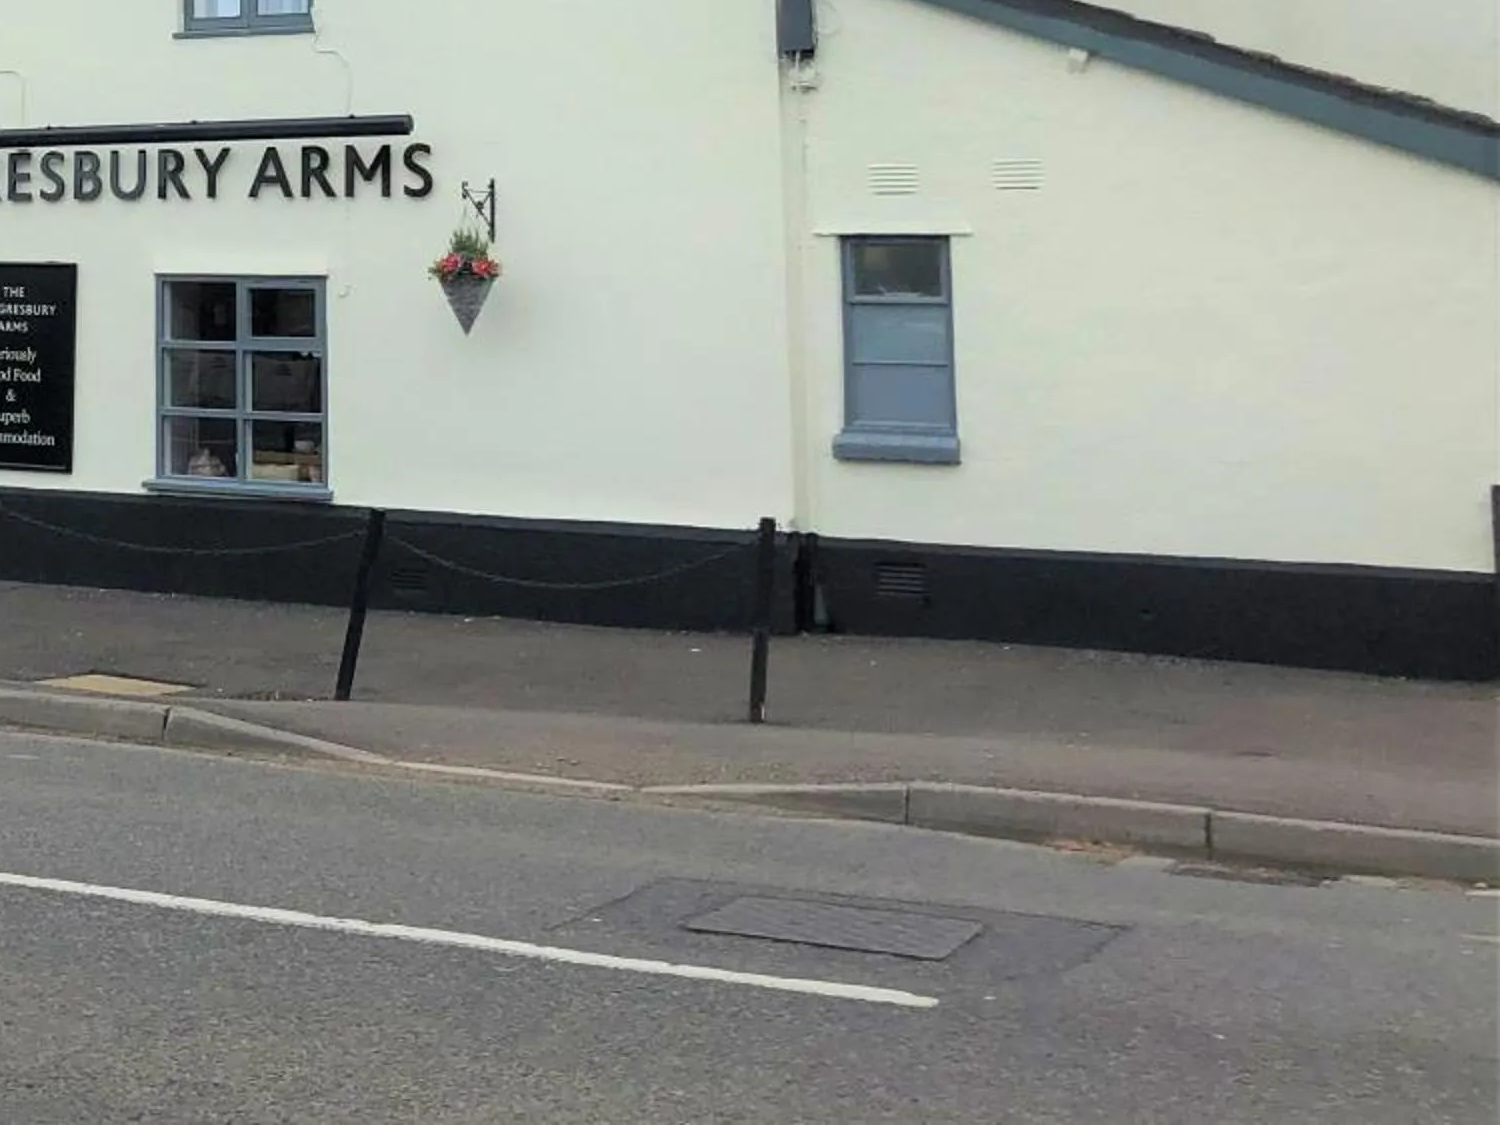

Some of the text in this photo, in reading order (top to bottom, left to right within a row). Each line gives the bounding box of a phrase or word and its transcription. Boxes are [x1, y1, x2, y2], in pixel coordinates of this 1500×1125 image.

[248, 142, 435, 199] ARMS
[3, 286, 25, 298] THE
[13, 367, 42, 383] Food
[5, 388, 17, 402] &
